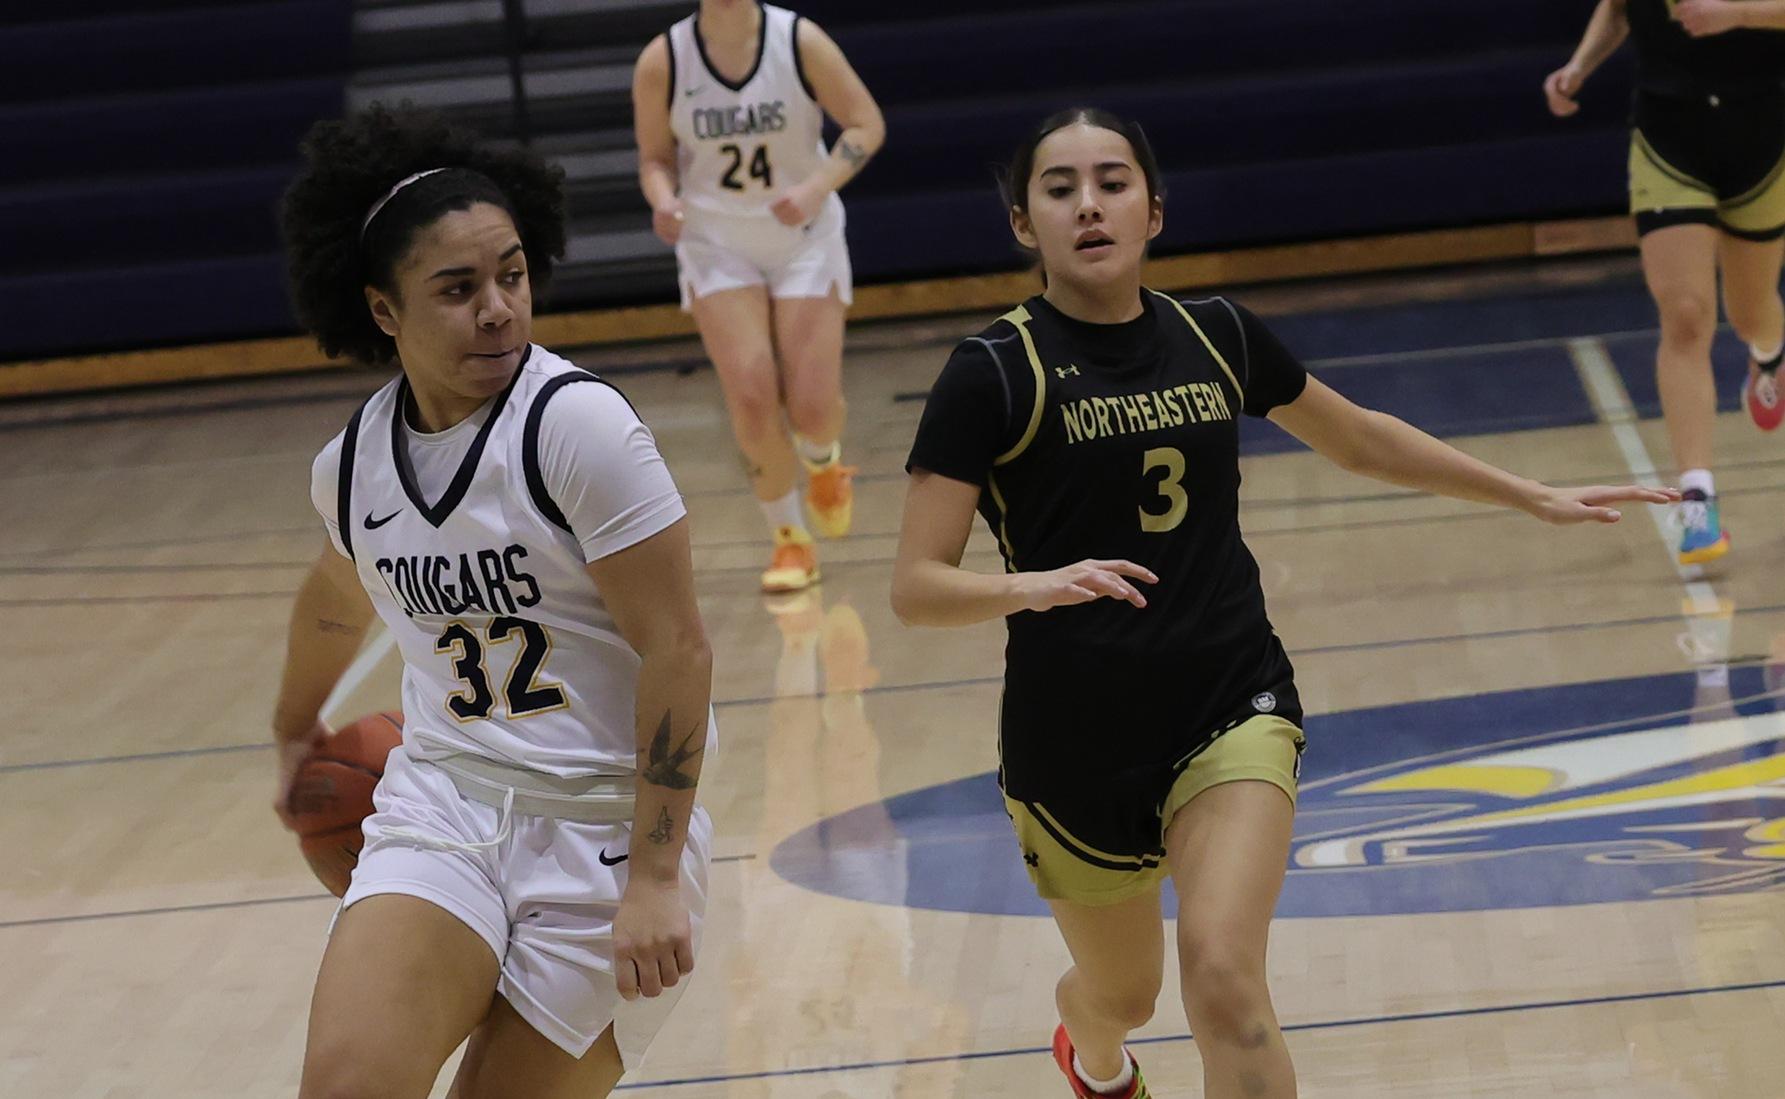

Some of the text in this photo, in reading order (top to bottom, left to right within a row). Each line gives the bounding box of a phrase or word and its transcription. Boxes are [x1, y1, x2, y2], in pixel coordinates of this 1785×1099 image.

[693, 101, 786, 139] COUGARS
[719, 143, 771, 190] 24
[1060, 382, 1232, 444] NORTHEASTERN
[1138, 447, 1188, 533] 3
[375, 543, 542, 618] COUGARS
[434, 615, 570, 723] 32
